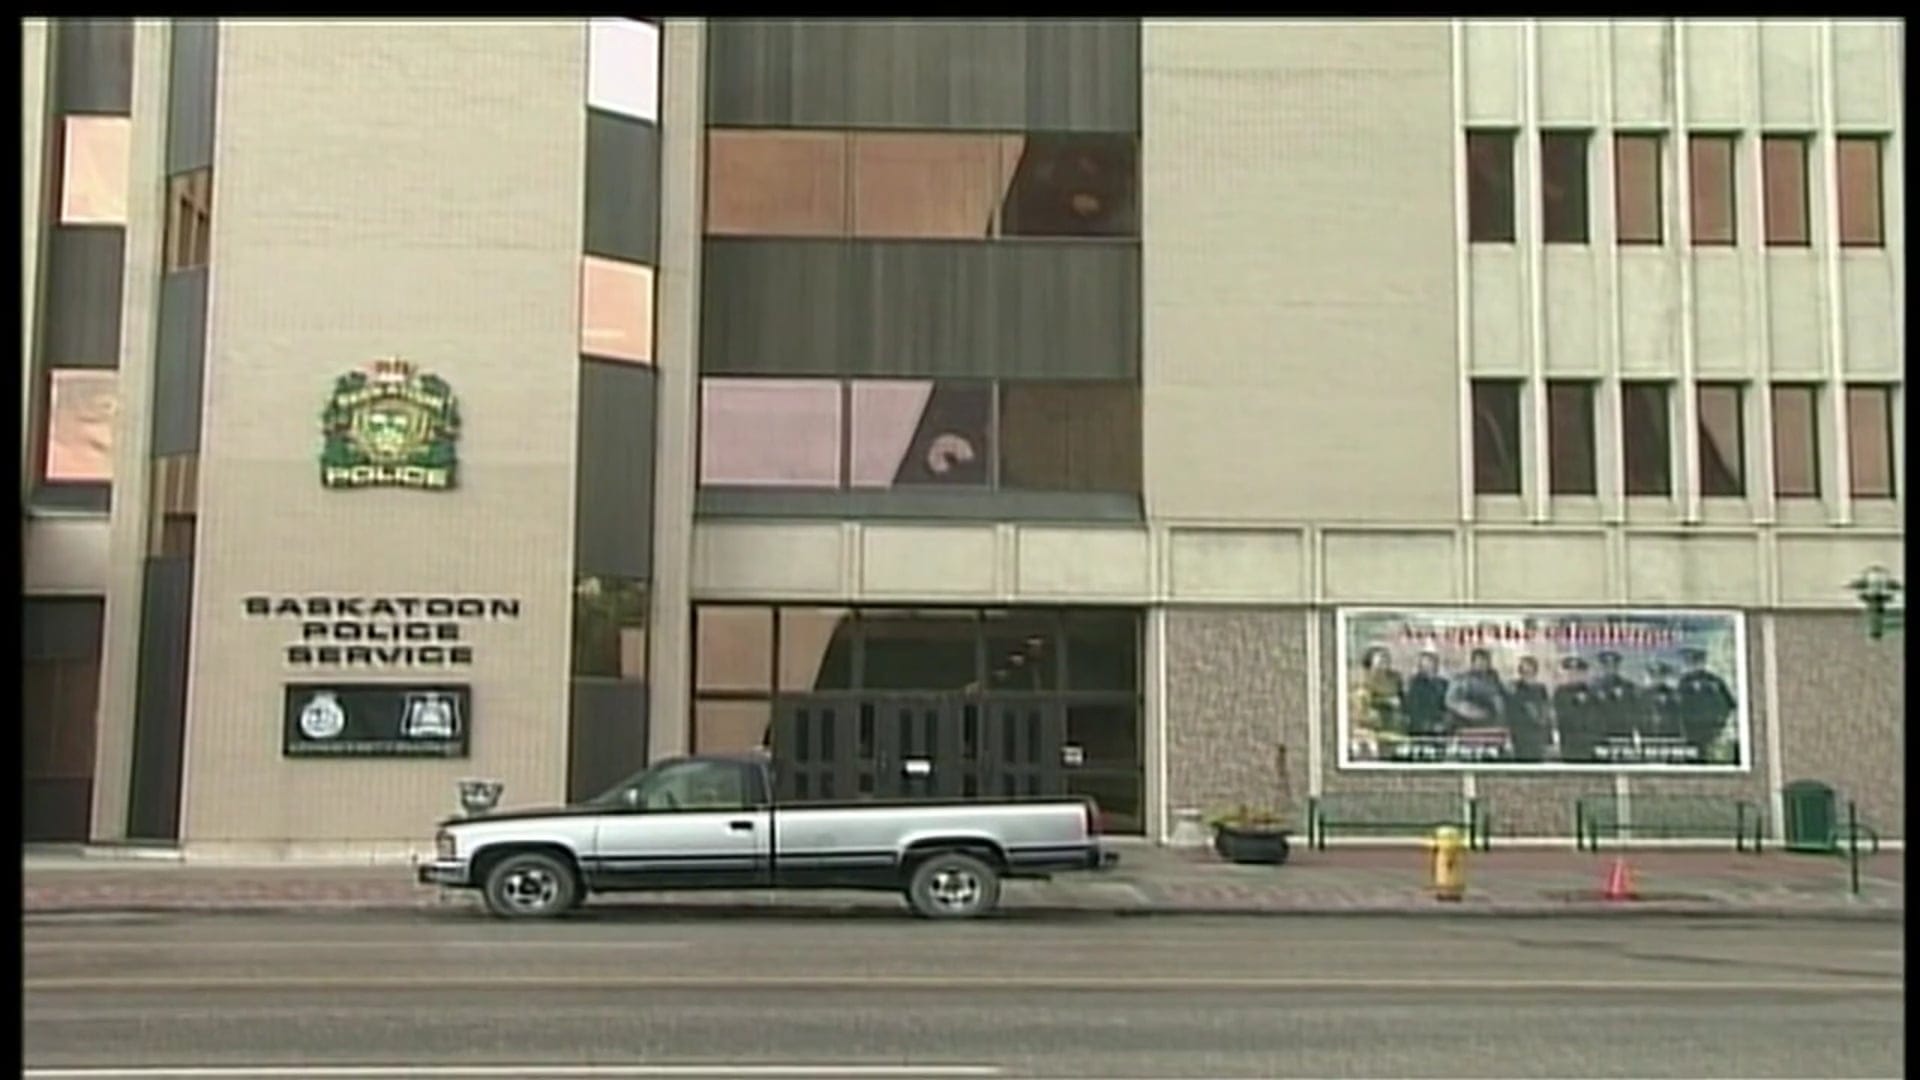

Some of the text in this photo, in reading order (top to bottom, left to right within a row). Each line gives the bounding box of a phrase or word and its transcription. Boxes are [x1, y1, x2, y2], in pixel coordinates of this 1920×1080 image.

[325, 465, 450, 486] POLICE
[245, 596, 521, 617] SASKATOON
[302, 620, 461, 641] POLICE
[286, 646, 473, 665] SERVICE
